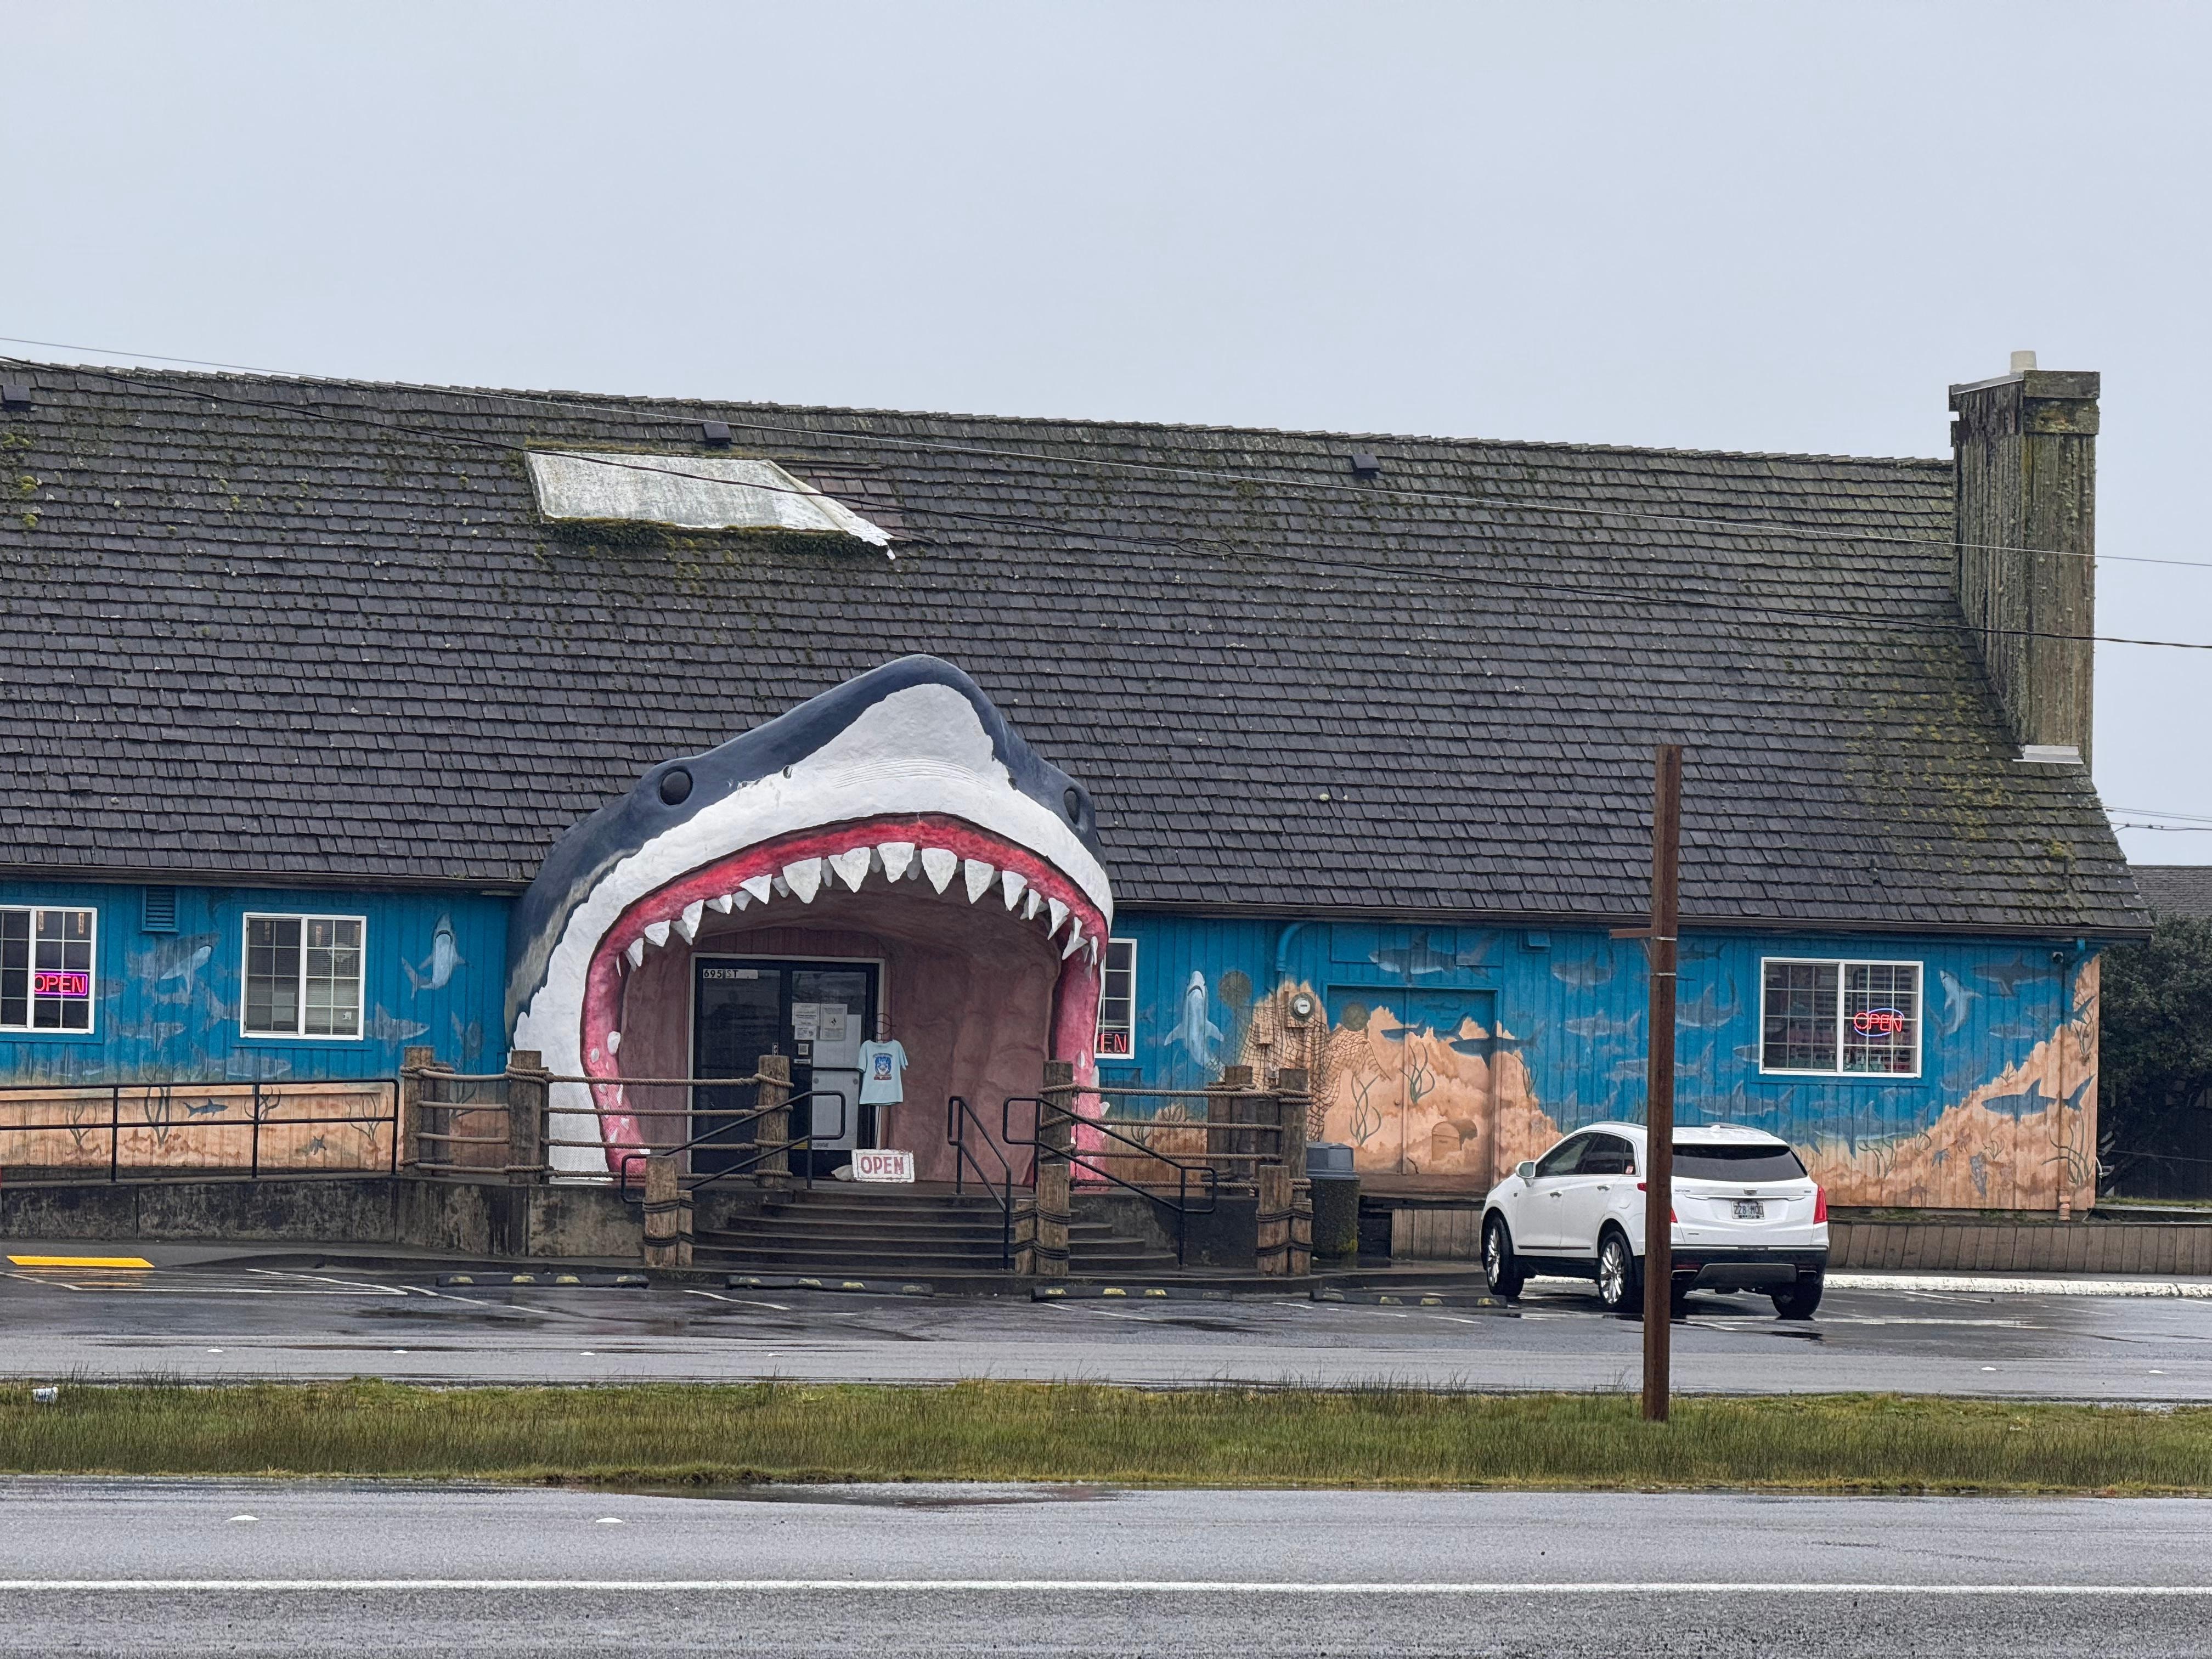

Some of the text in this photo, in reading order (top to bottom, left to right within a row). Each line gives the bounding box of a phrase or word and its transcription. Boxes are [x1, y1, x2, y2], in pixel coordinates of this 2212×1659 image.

[704, 969, 738, 978] 695 ST
[35, 975, 84, 993] OPEN
[1854, 1012, 1903, 1032] OPEN
[1097, 1034, 1126, 1053] EN
[860, 1156, 904, 1174] OPEN
